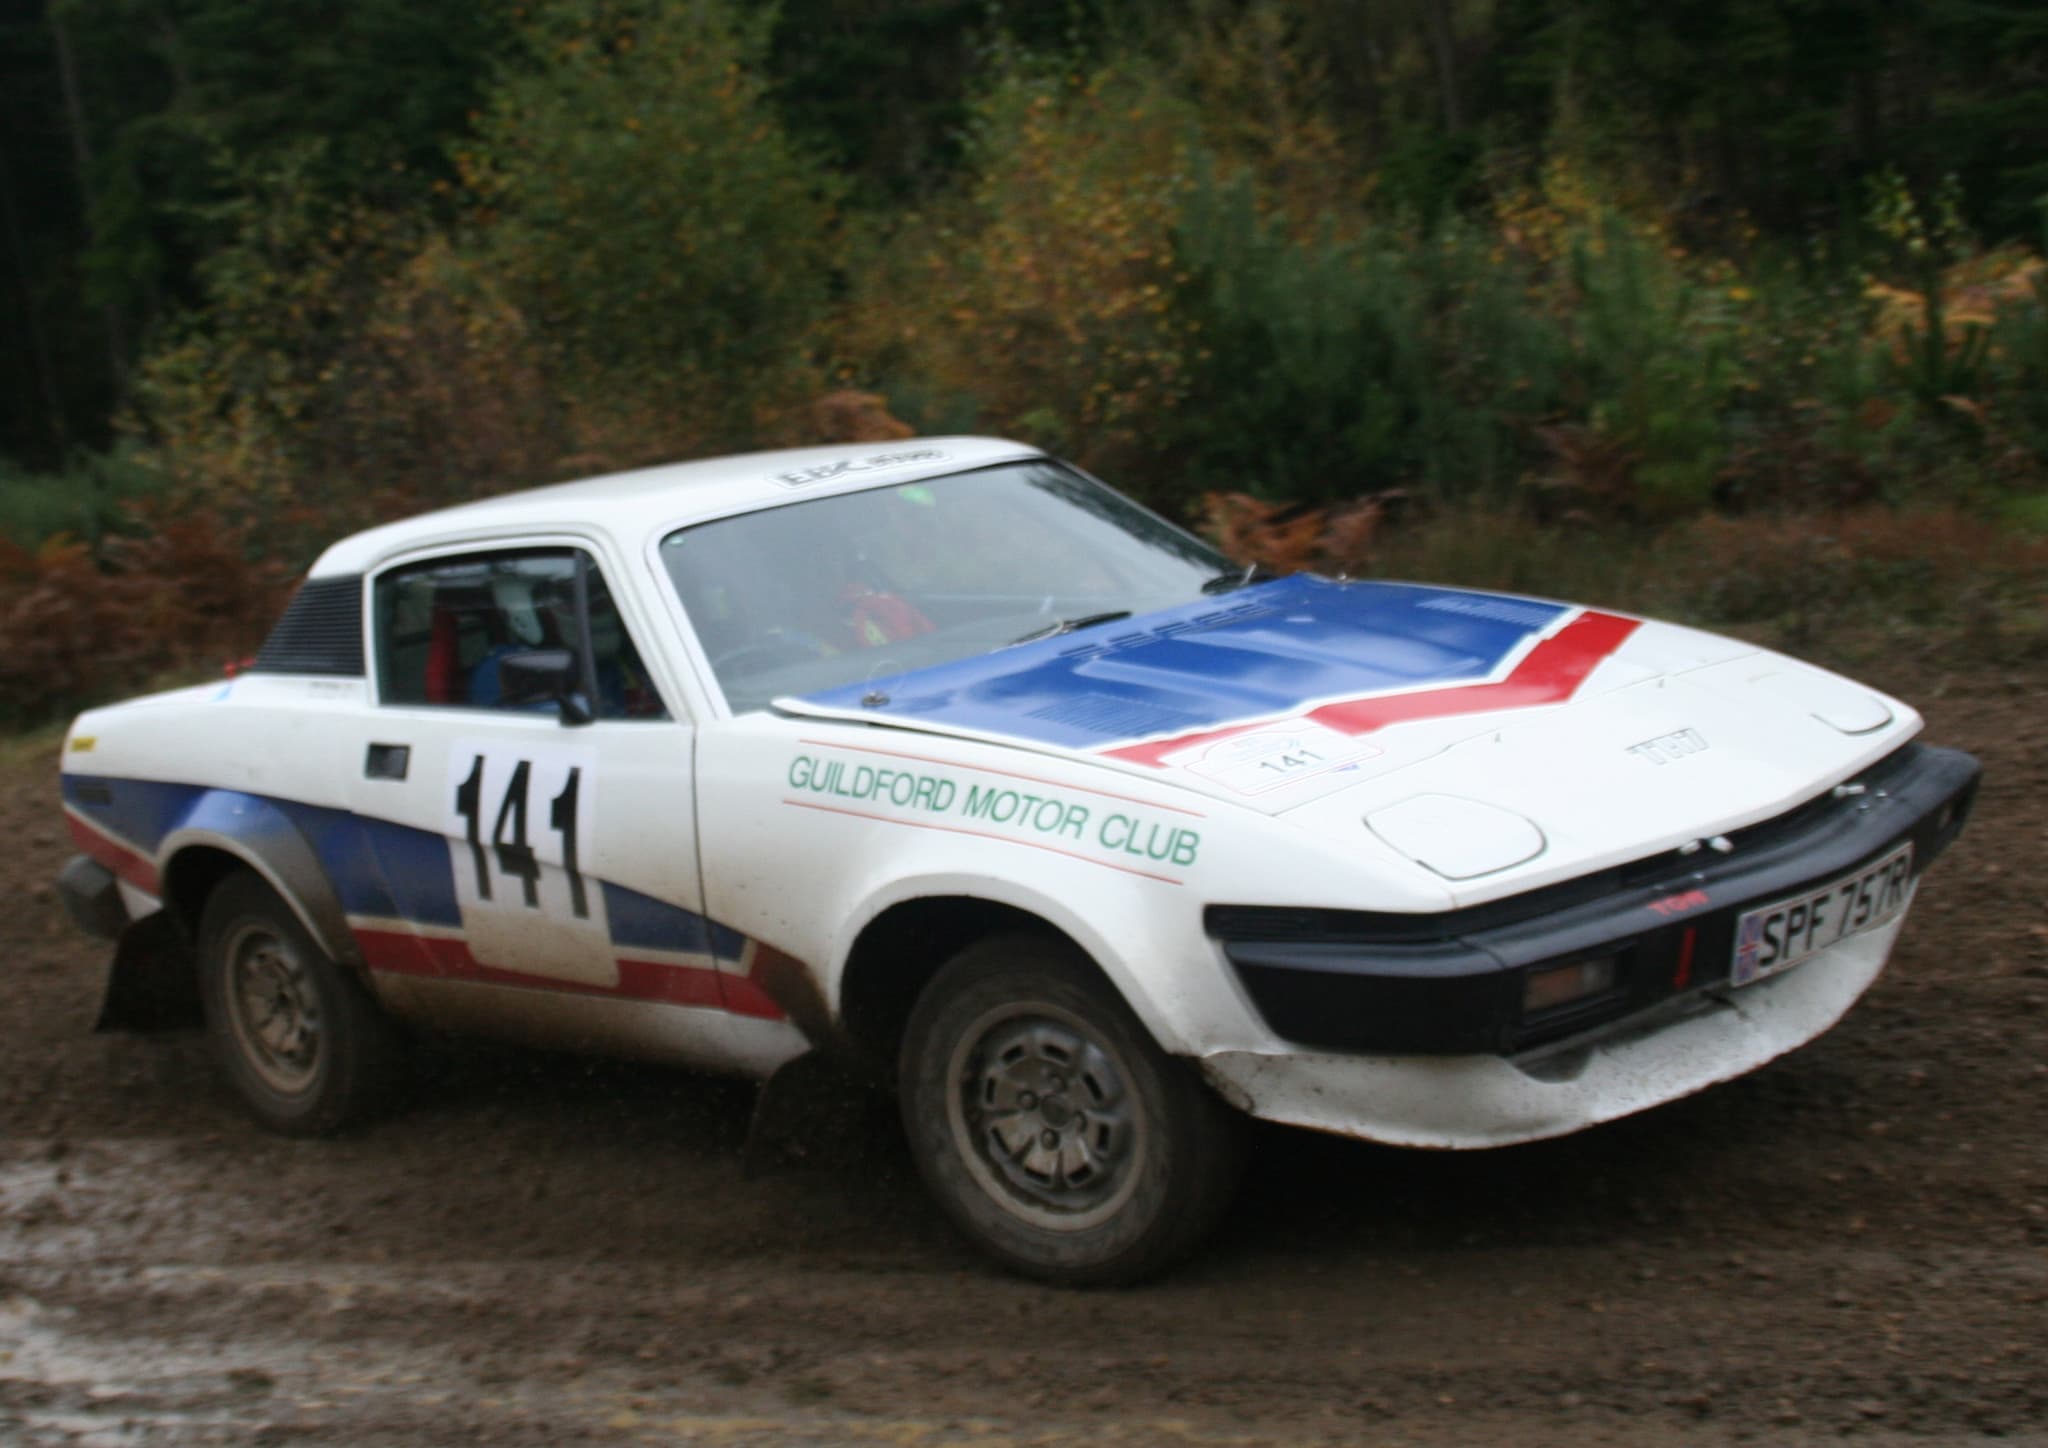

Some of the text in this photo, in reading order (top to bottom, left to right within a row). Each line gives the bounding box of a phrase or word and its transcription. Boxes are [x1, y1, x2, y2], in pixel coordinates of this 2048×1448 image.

[788, 755, 1201, 867] GUILDFORD MOTOR CLUB
[1259, 749, 1325, 774] 141
[456, 754, 590, 920] 141
[1759, 854, 1908, 967] SPF 757R
